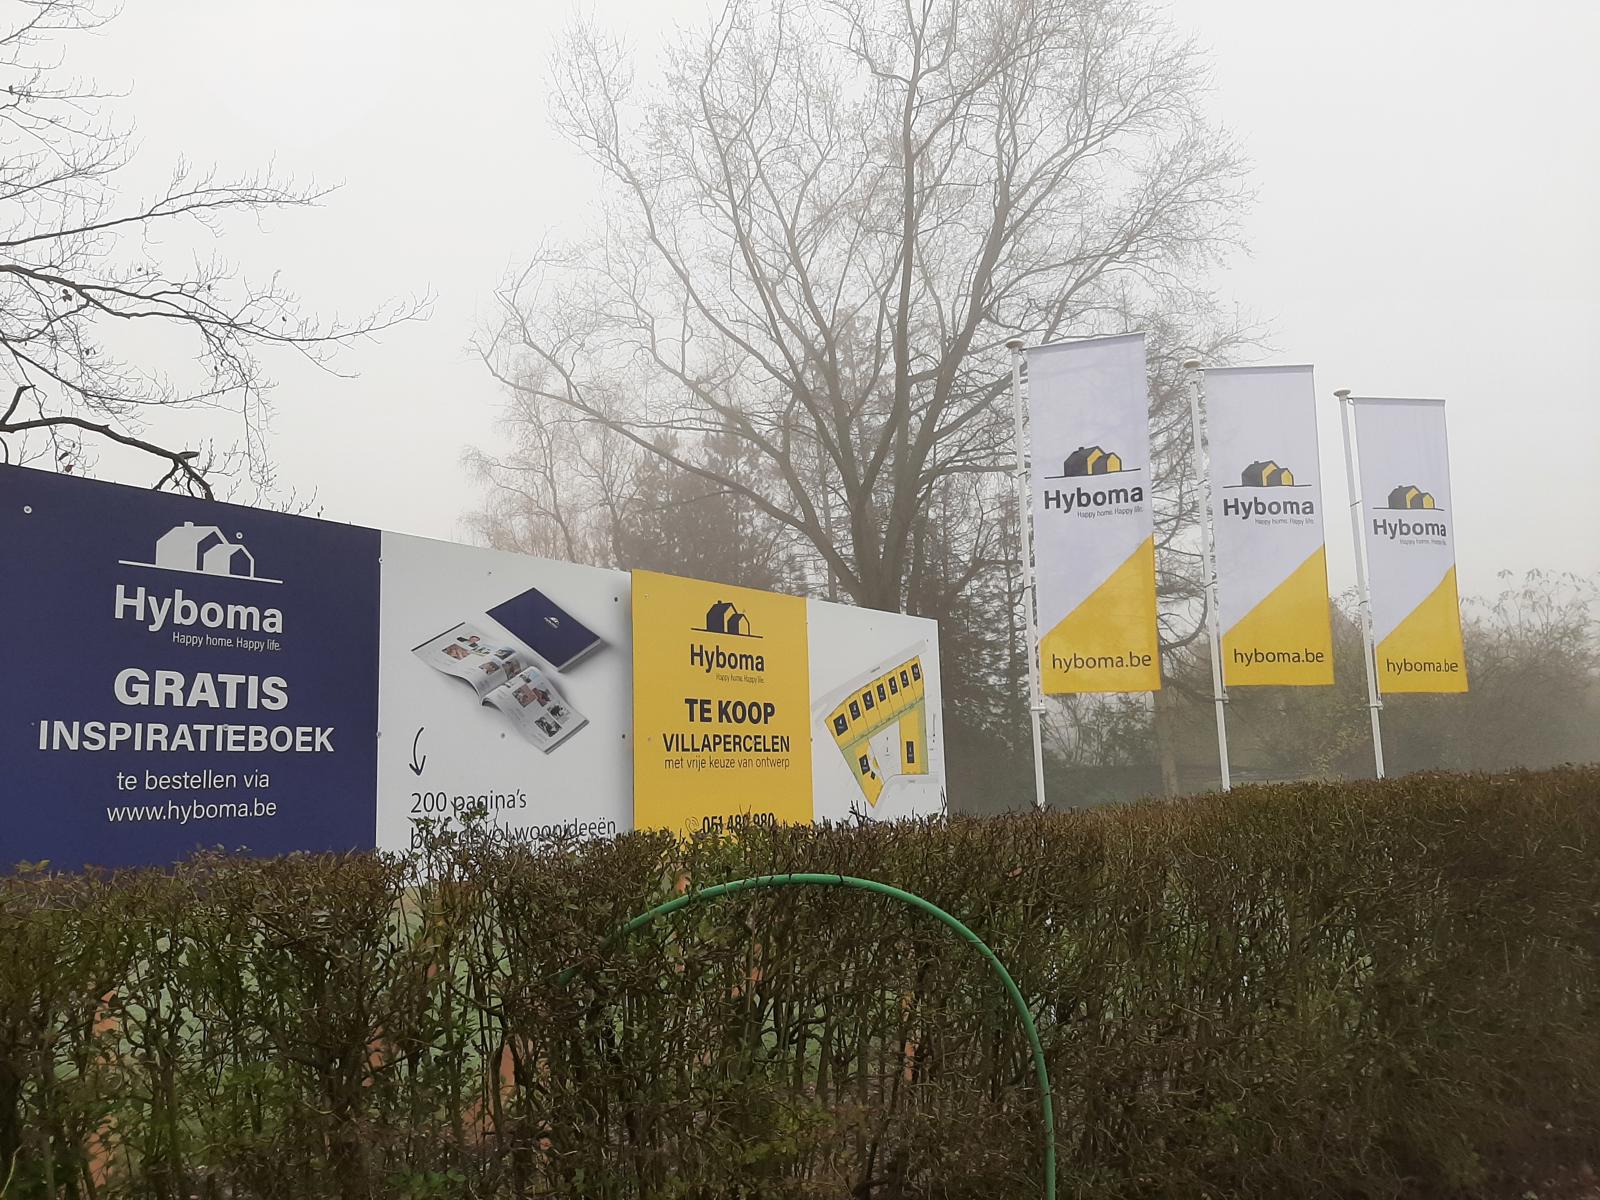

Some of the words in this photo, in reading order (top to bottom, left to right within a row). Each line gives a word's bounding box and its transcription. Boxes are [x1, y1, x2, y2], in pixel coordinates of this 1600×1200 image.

[1044, 486, 1143, 513] Hyboma
[1223, 496, 1314, 519] Hyboma
[1372, 518, 1447, 540] Hyboma
[114, 584, 284, 633] Hyboma
[172, 631, 204, 648] Happy
[205, 634, 234, 648] home.
[236, 636, 265, 653] Happy
[266, 638, 282, 651] life.
[690, 643, 765, 673] Hyboma
[1052, 651, 1152, 674] hyboma.be
[1233, 648, 1324, 667] hyboma.be
[1386, 658, 1459, 676] hyboma.be
[114, 667, 289, 711] GRATIS
[685, 698, 713, 723] TE
[718, 700, 776, 725] KOOP
[39, 720, 335, 752] INSPIRATIEBOEK
[662, 733, 790, 752] VILLAPERCELEN
[664, 757, 683, 769] met
[687, 755, 706, 771] vrije
[709, 756, 736, 769] keuze
[738, 758, 753, 768] van
[755, 757, 790, 770] ontwerp
[116, 772, 137, 791] te
[145, 769, 236, 790] bestellen
[243, 769, 270, 788] via
[107, 797, 277, 824] www.hyboma.be
[411, 792, 447, 814] 200
[453, 788, 527, 817] pagina's
[702, 816, 723, 834] 051
